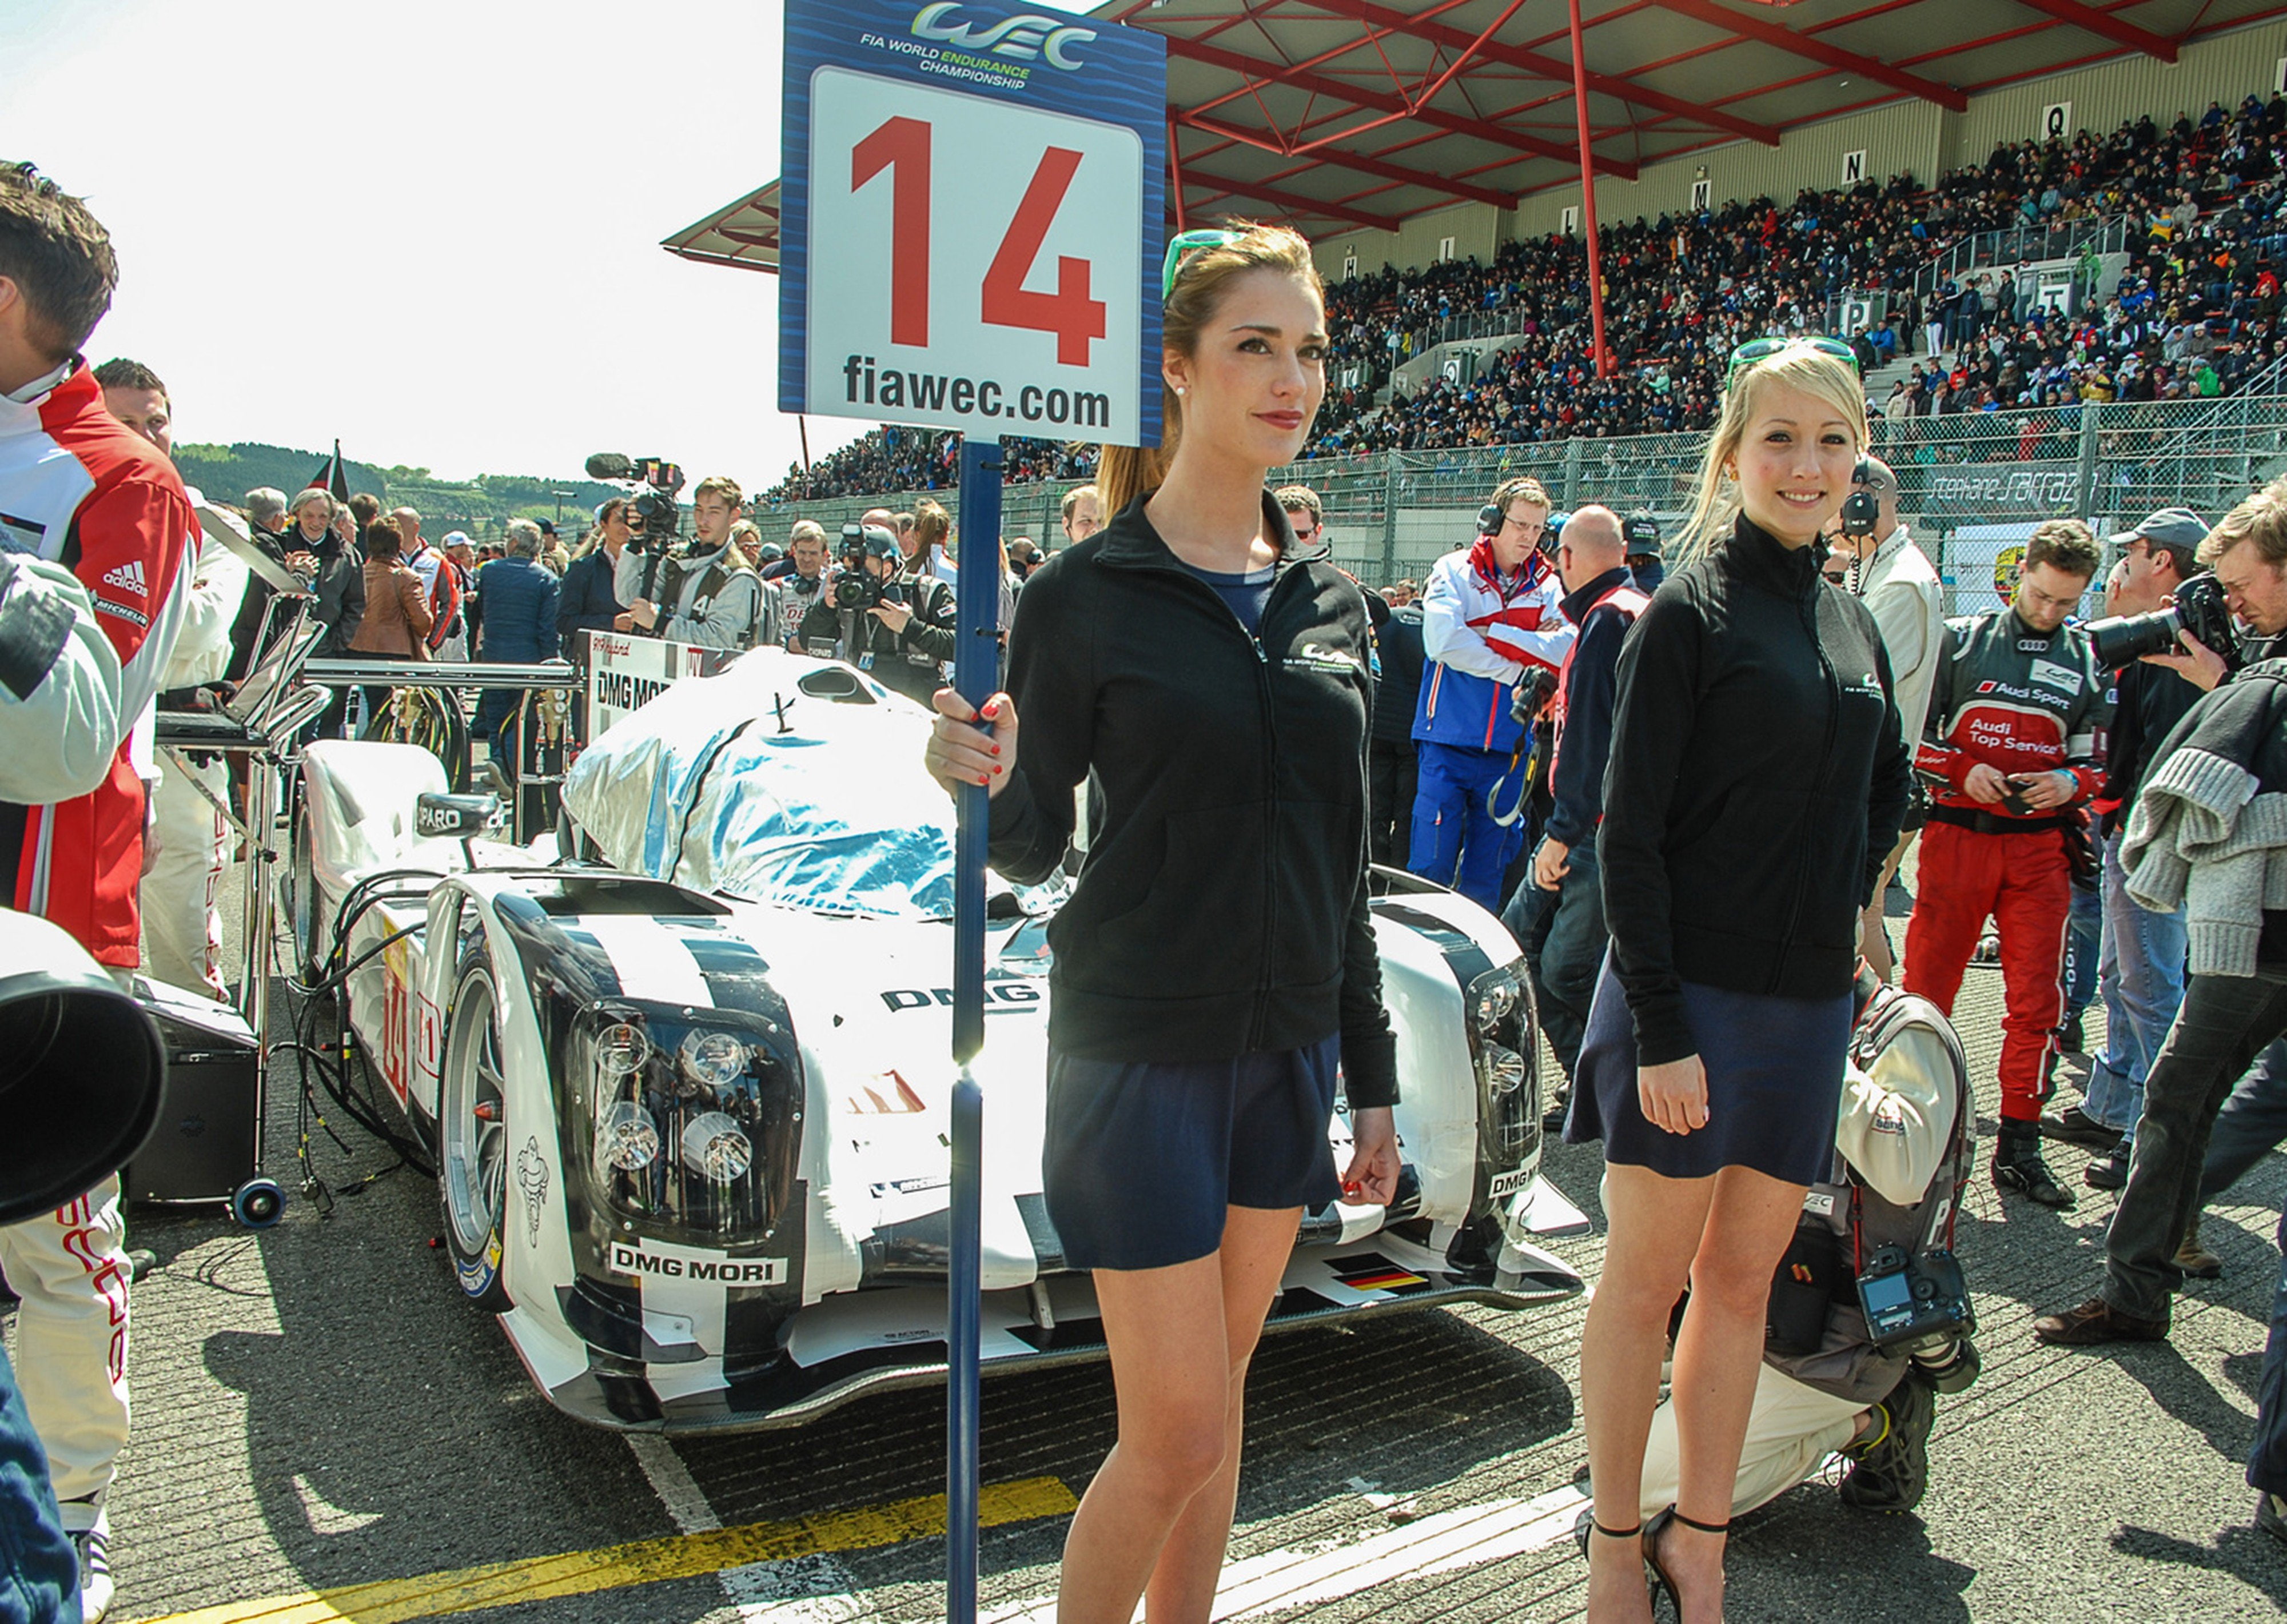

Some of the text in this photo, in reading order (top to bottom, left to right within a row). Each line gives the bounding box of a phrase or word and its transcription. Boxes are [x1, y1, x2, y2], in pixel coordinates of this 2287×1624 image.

[911, 2, 1097, 70] WEC
[860, 34, 1031, 79] FIA WORLD ENDURANCE
[920, 60, 1025, 90] CHAMPIONSHIP
[2048, 107, 2064, 135] Q
[1847, 154, 1861, 181] N
[1695, 183, 1707, 208] M
[851, 115, 1106, 367] 14
[1347, 259, 1354, 278] H
[2044, 290, 2063, 312] T
[1848, 304, 1864, 336] P
[843, 355, 1109, 428] fiawec.com
[103, 573, 148, 598] adidas
[96, 600, 148, 625] MICHELIN
[598, 671, 631, 709] DMG
[1996, 683, 2071, 710] Audi Sport
[1970, 719, 2011, 735] Audi
[1970, 731, 2058, 755] Top Service
[1493, 1171, 1526, 1195] DMG
[616, 1248, 774, 1281] DMG MORI
